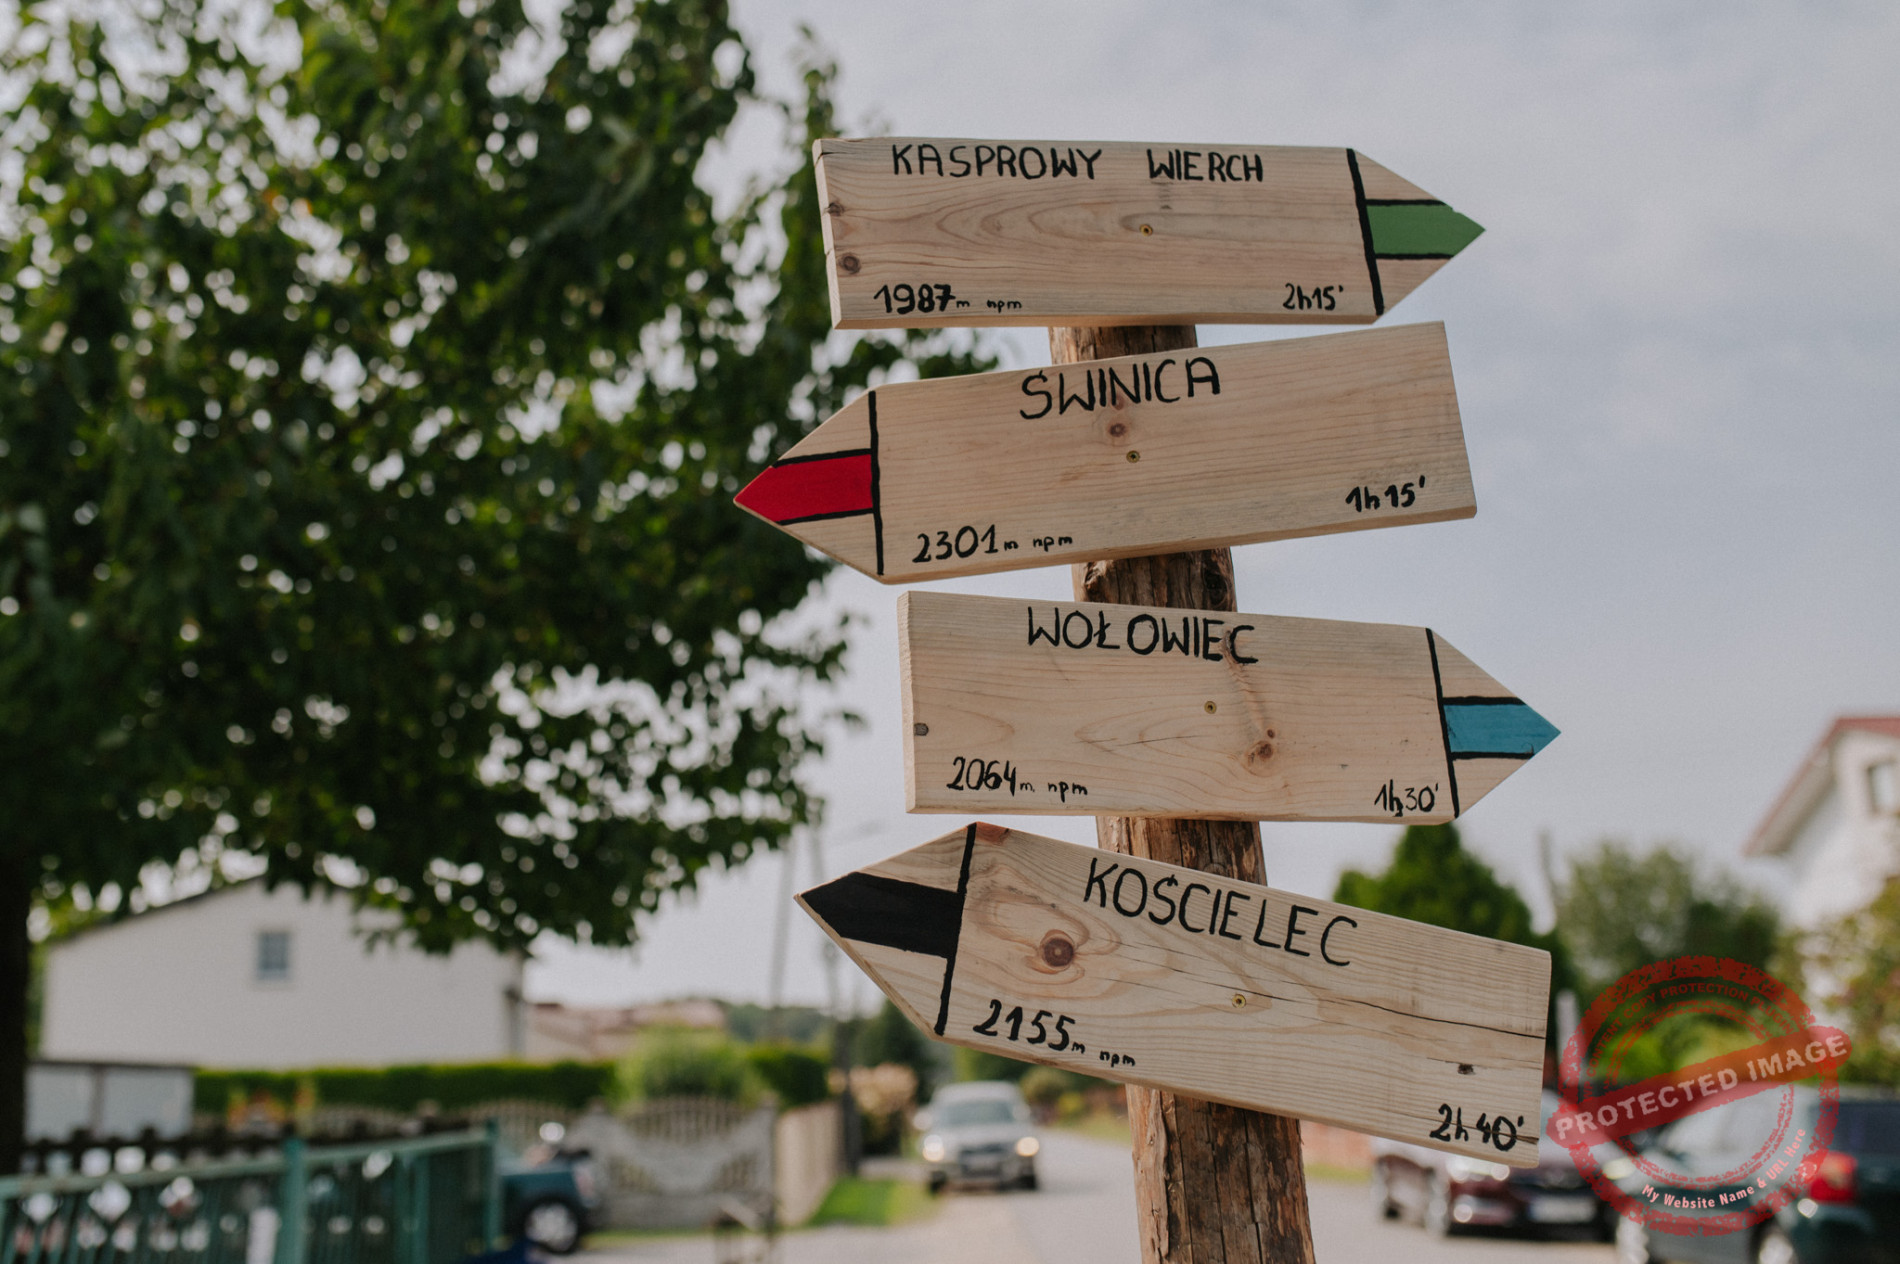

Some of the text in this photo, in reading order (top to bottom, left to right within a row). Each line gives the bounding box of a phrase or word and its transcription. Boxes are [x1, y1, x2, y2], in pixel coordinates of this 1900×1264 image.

[892, 143, 1264, 182] KASPROWY WIERCH
[1032, 536, 1073, 552] npm
[1028, 606, 1258, 665] WOŁOWIEC
[1047, 781, 1088, 803] npm
[1084, 857, 1358, 967] KOŚCIELEC
